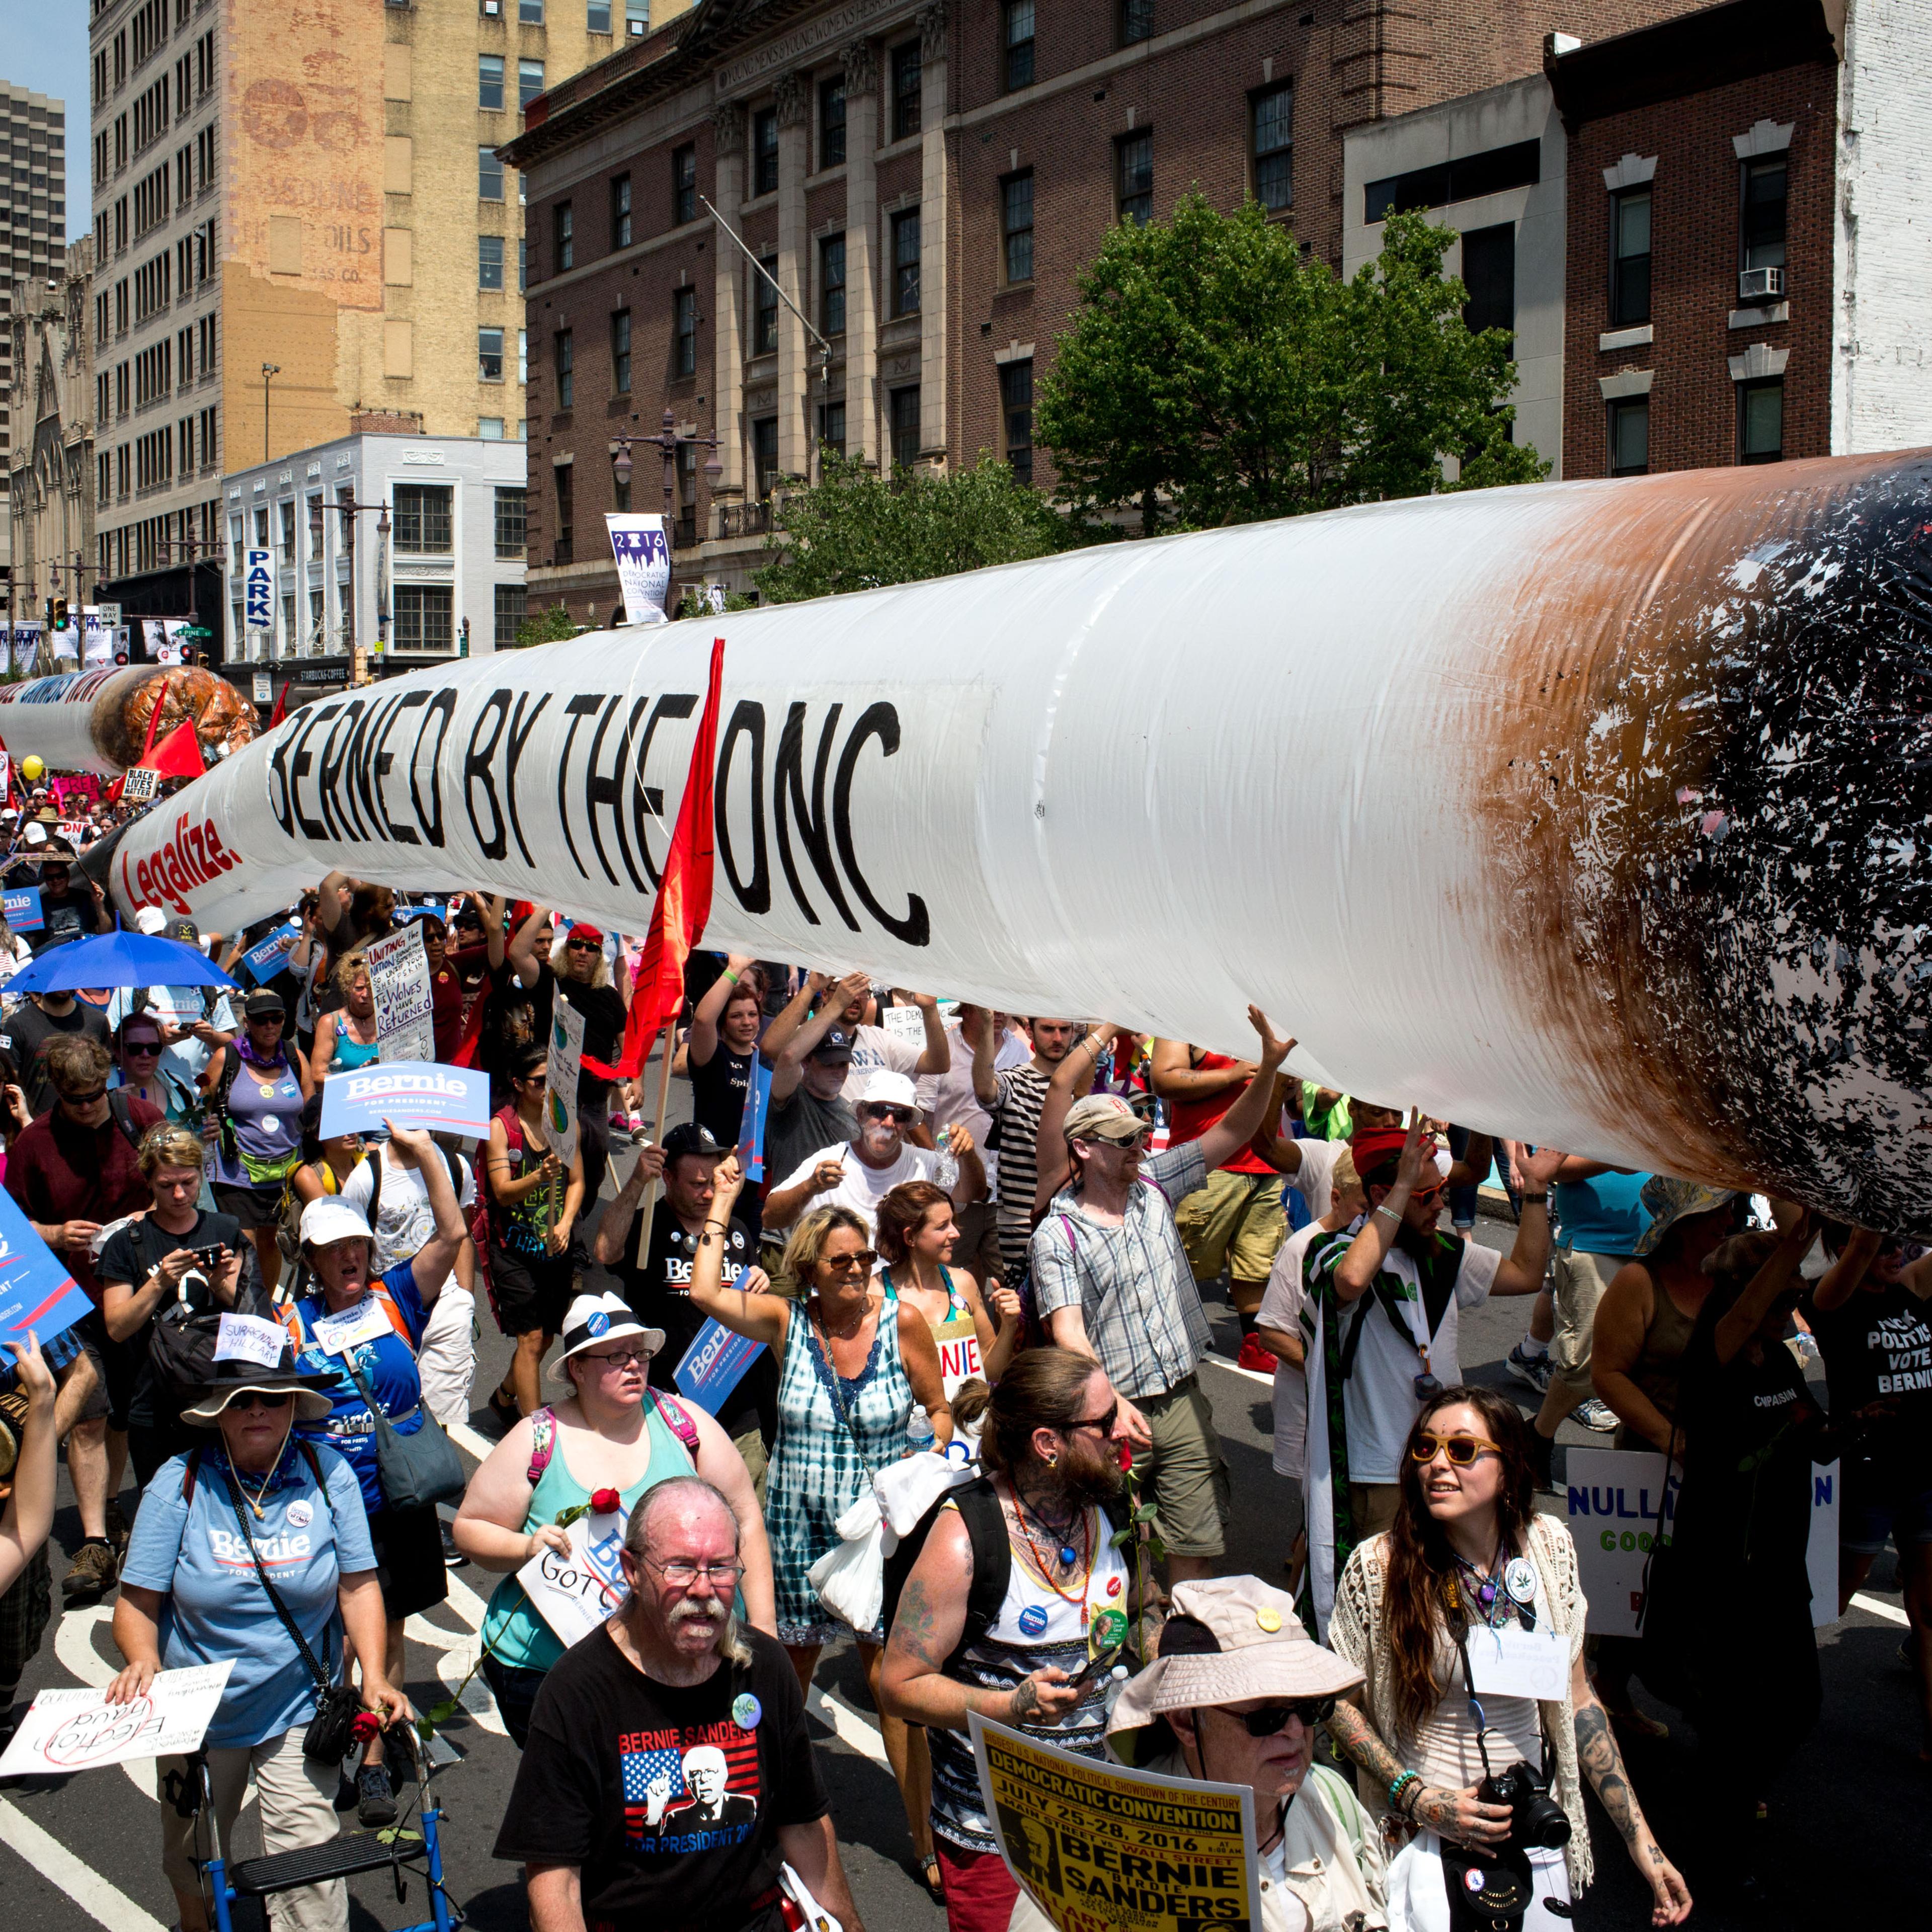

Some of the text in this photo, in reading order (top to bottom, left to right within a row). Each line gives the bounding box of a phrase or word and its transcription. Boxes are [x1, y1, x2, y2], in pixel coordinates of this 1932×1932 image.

[248, 551, 272, 617] PARK
[301, 669, 345, 680] STARBUCKS COFFEE
[126, 778, 152, 790] LIVES
[128, 769, 154, 780] BLACK
[124, 788, 151, 797] MATTER
[464, 689, 553, 868] BY
[558, 693, 699, 895] THE
[122, 812, 243, 916] Legalize.
[369, 930, 419, 965] UNITING the
[373, 977, 381, 987] SO
[407, 954, 424, 967] YOUR
[395, 997, 414, 1013] HAVE
[885, 1012, 903, 1024] THE
[895, 1026, 922, 1037] IS THE
[856, 1067, 880, 1075] BERNI
[346, 1072, 468, 1099] Bernie
[388, 1098, 447, 1107] PRESIDENT
[1110, 1098, 1128, 1114] B
[665, 1256, 743, 1281] Beie
[1879, 1309, 1917, 1331] FUCK
[225, 1324, 278, 1352] SURRENDER
[229, 1338, 277, 1363] HILLARY
[687, 1324, 733, 1384] Ber
[708, 1336, 744, 1383] FOR PRESIDE
[941, 1338, 981, 1377] NIE
[1888, 1347, 1931, 1371] VOTE
[1877, 1369, 1932, 1394] BERNI
[229, 1569, 296, 1580] FOR PDENT
[541, 1550, 602, 1597] GOT
[1023, 1611, 1046, 1626] Bernie
[33, 1716, 166, 1753] Election
[619, 1729, 680, 1754] BERNIE
[985, 1730, 1240, 1809] BIGGEST U.S. NATIONAL POLITICAL SHOWDOWN OF THE CENTURY
[990, 1749, 1236, 1830] DEMOCRATIC CONVENTION
[996, 1779, 1050, 1812] JULY
[1057, 1805, 1130, 1841] 25-28,
[1137, 1830, 1198, 1852] 2016
[660, 1827, 734, 1855] PRESIDENT
[1004, 1797, 1039, 1819] MAIN
[1044, 1814, 1096, 1843] STREET
[1121, 1844, 1169, 1861] WALL
[1173, 1854, 1234, 1867] STREET
[1062, 1830, 1240, 1889] BERNIE
[1064, 1865, 1241, 1919] SANDERS
